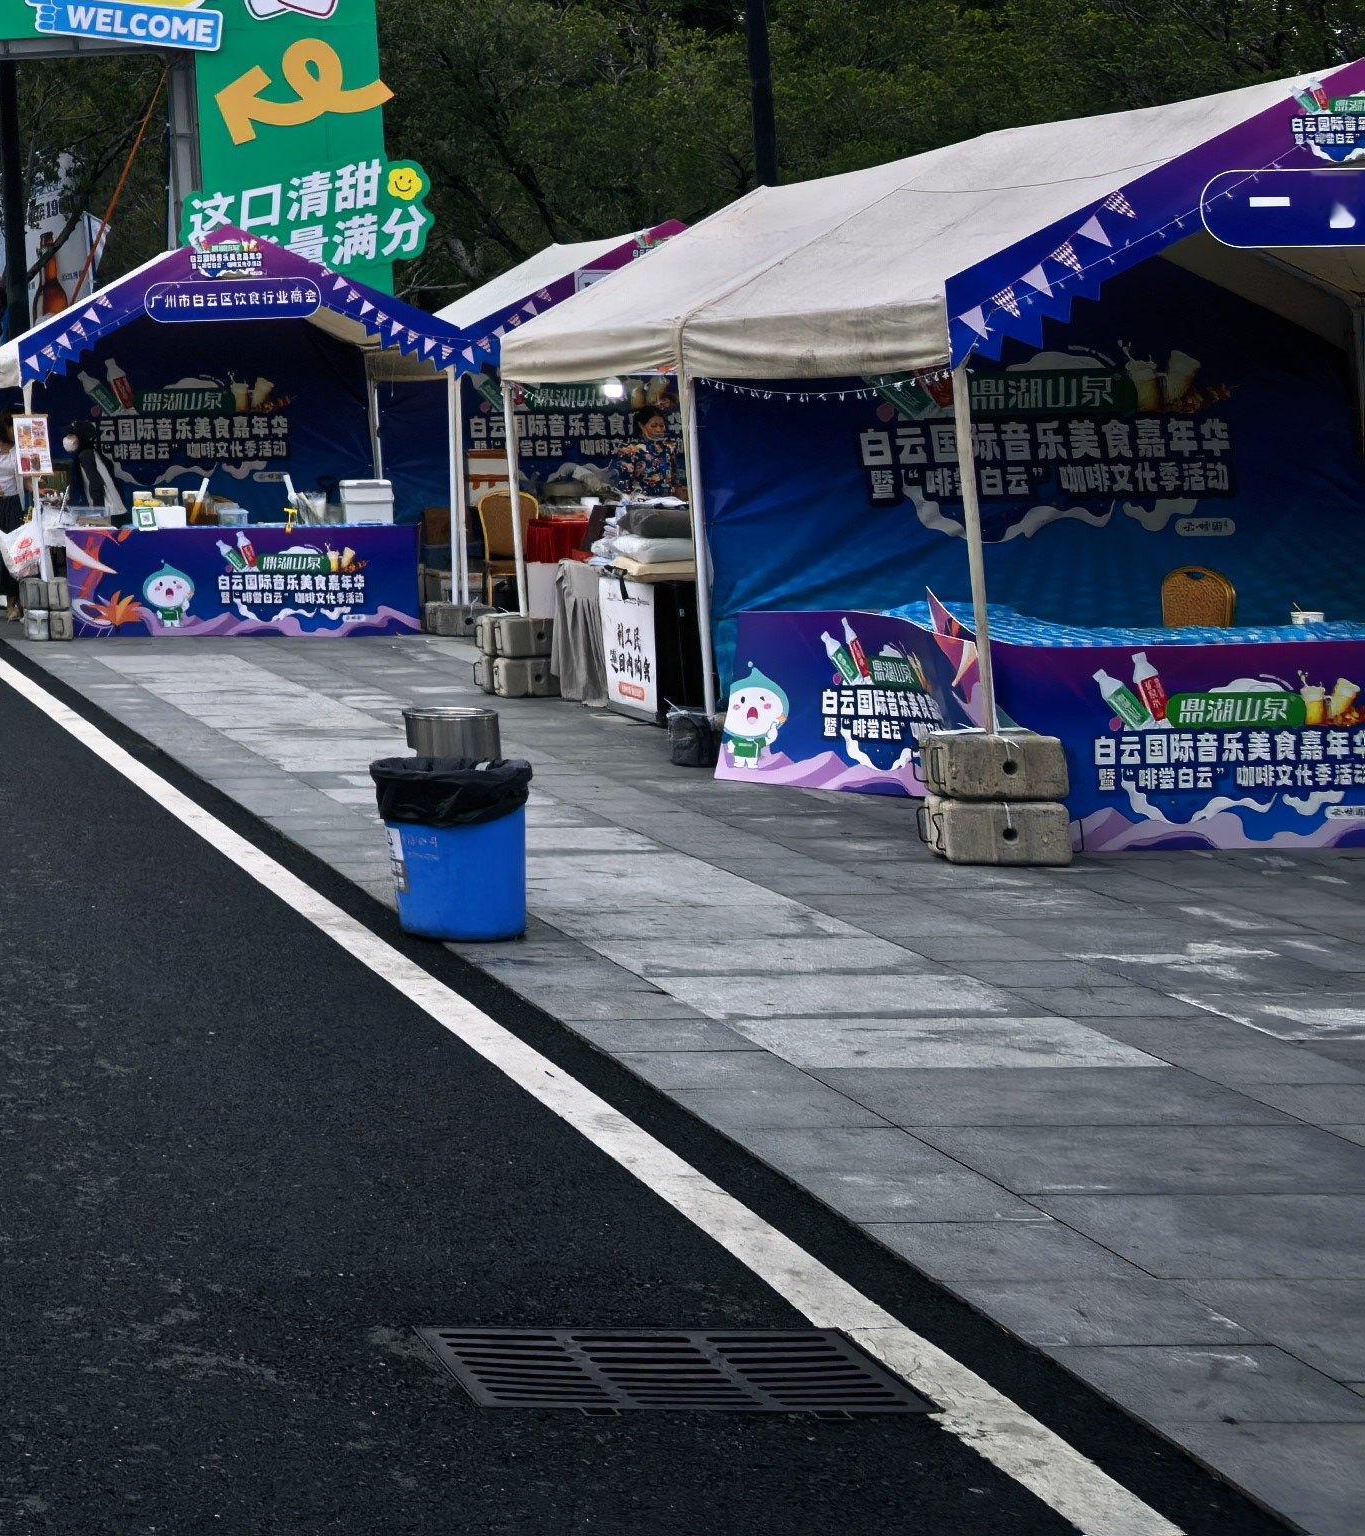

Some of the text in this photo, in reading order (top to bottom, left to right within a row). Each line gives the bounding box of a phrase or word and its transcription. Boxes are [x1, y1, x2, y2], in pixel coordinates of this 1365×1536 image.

[66, 3, 216, 46] WELCOME
[189, 159, 382, 252] 这口清甜
[262, 205, 427, 267] 量满分
[150, 289, 317, 309] 广州市白云区饮食行业商会
[970, 375, 1114, 411] 鼎湖山泉
[94, 416, 288, 441] 云国际音乐美食嘉年华
[859, 418, 1232, 466] 白云国际音乐美食嘉年华
[1179, 698, 1287, 723] 鼎湖山泉
